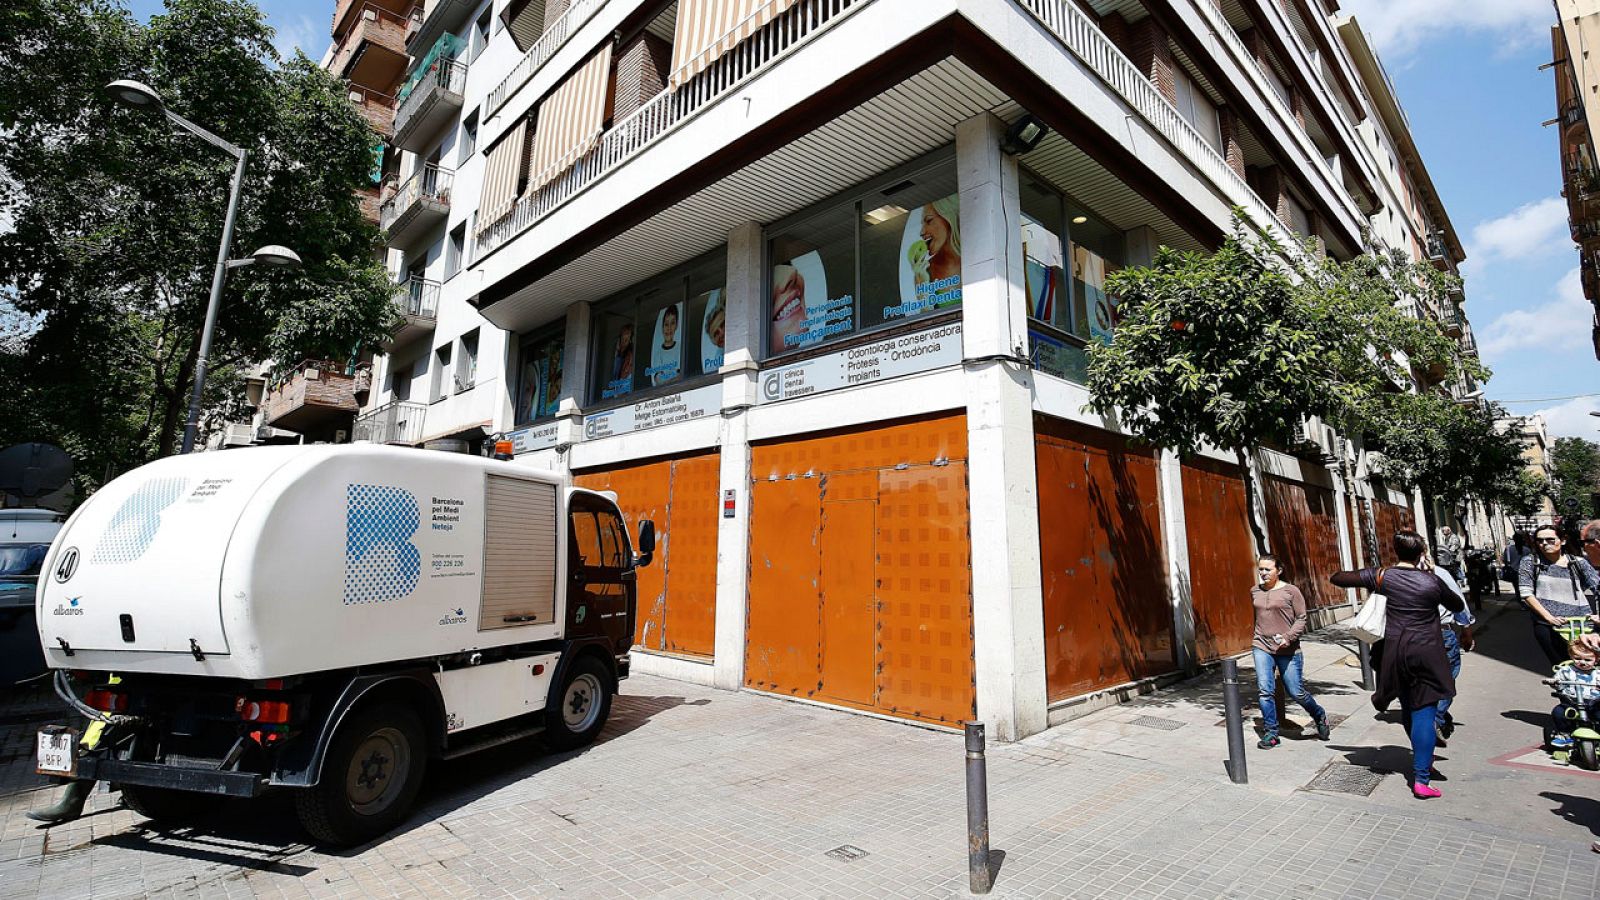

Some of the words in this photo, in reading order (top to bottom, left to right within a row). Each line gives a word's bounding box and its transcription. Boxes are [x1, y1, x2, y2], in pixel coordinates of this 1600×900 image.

[916, 274, 960, 295] Higiene
[883, 298, 926, 319] Profilaxi
[927, 289, 962, 305] Denta
[783, 320, 852, 347] Finançament
[848, 342, 896, 360] Odontologia
[899, 325, 961, 346] conservadora
[848, 357, 880, 371] Pròtesis
[891, 343, 941, 361] Ortodòncia
[784, 377, 805, 389] dental
[848, 370, 881, 383] Implants
[784, 385, 815, 398] travessera
[432, 497, 464, 506] Barcelona
[432, 506, 442, 514] pel
[432, 514, 460, 522] Ambient
[432, 523, 453, 532] Neteja
[57, 551, 77, 579] 40
